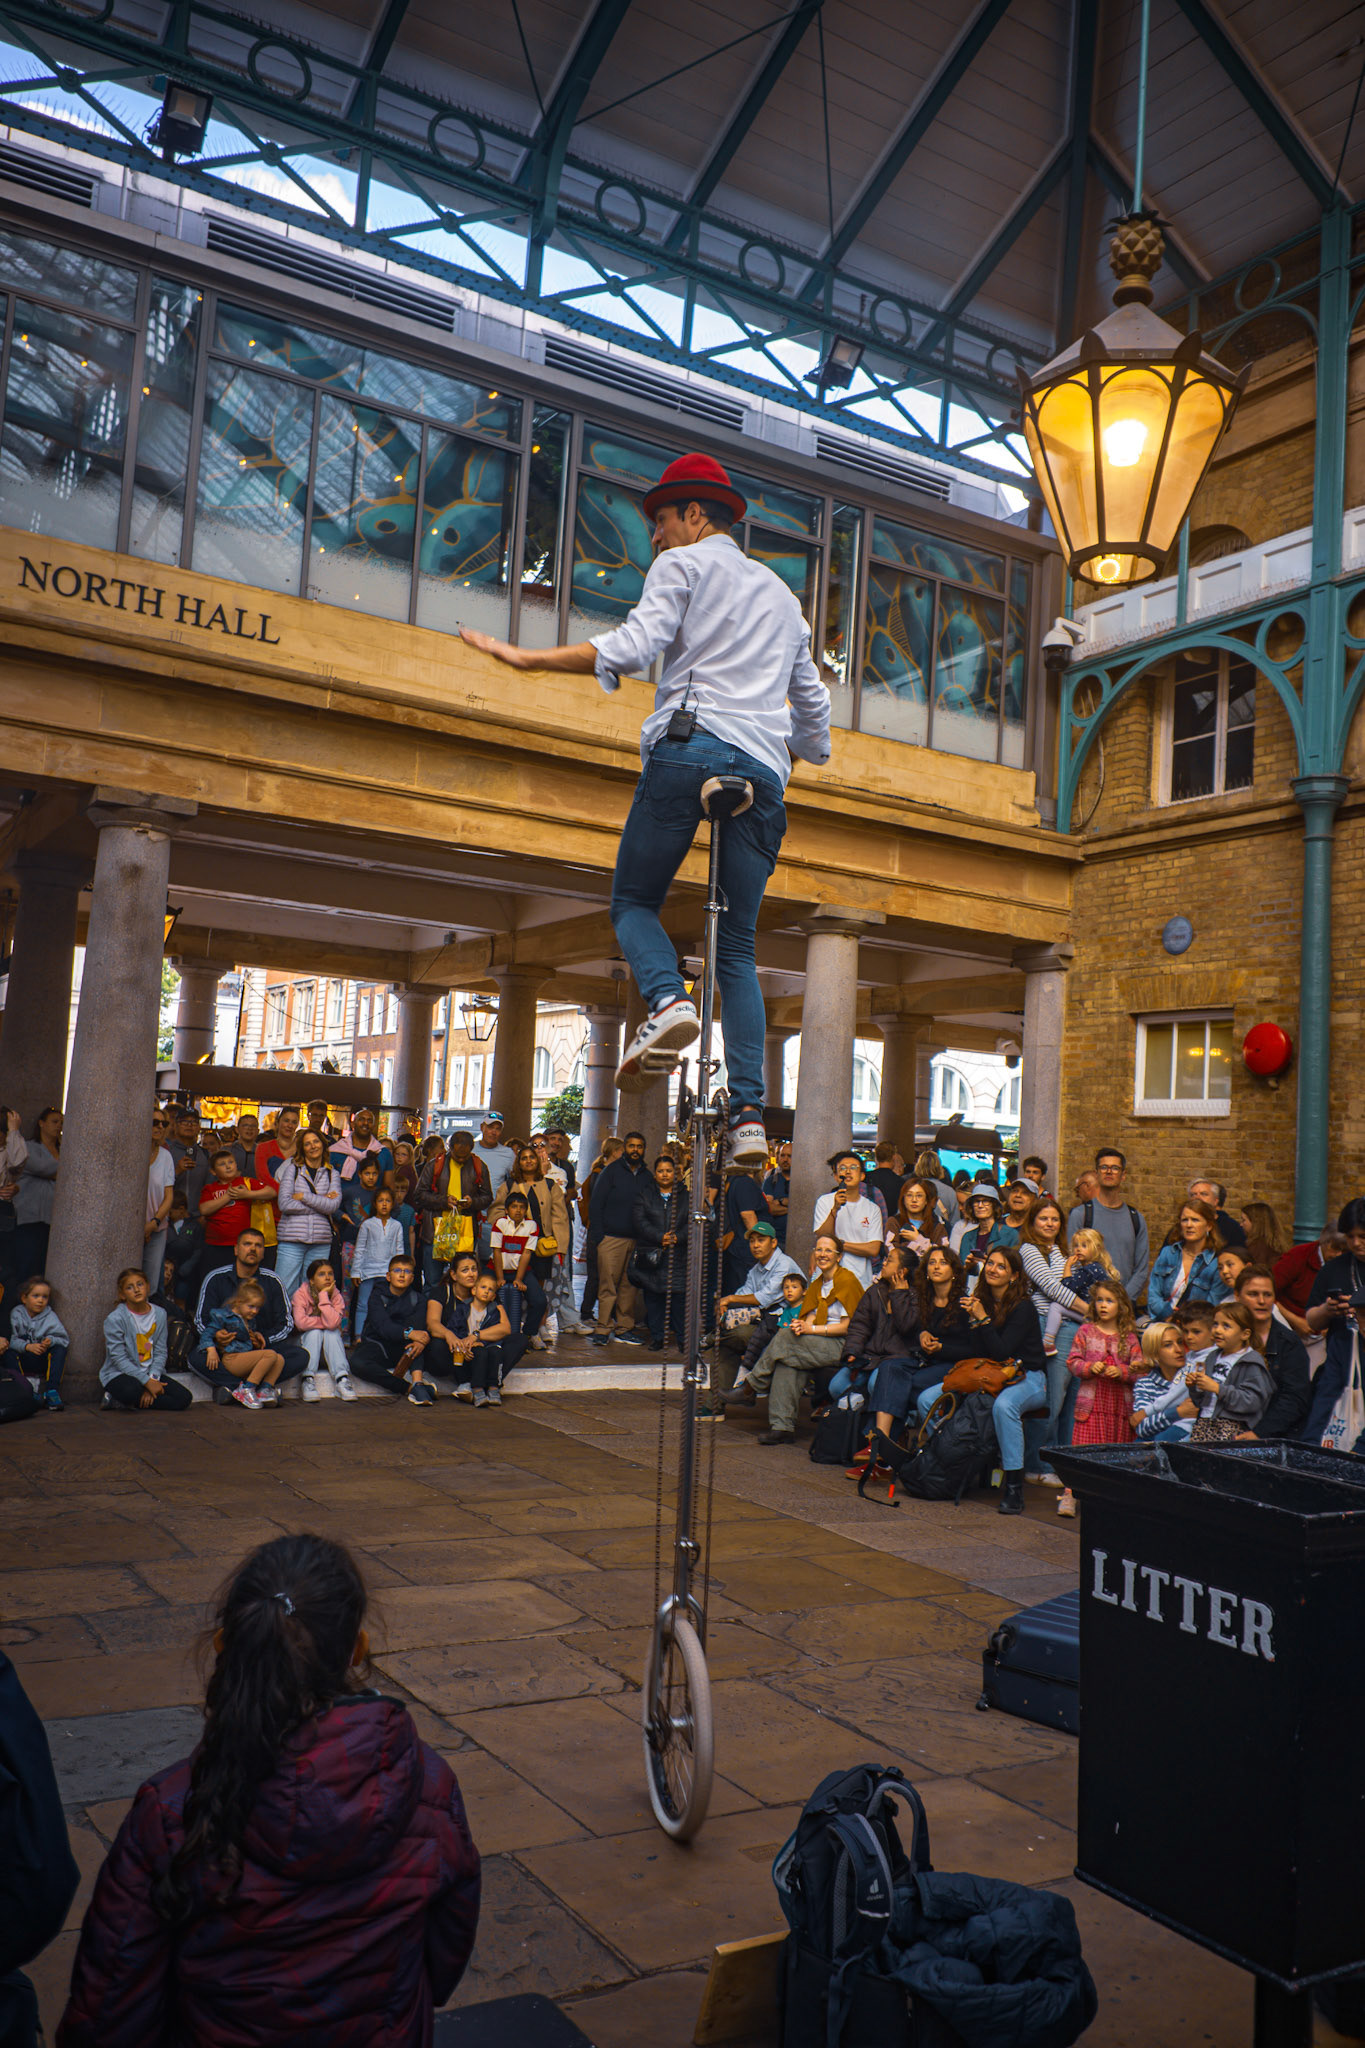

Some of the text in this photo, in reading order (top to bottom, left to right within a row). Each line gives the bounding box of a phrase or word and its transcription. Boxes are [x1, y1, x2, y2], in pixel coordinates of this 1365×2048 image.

[18, 556, 280, 645] NORTH HALL
[740, 1129, 764, 1138] adida
[1092, 1549, 1275, 1662] LITTER
